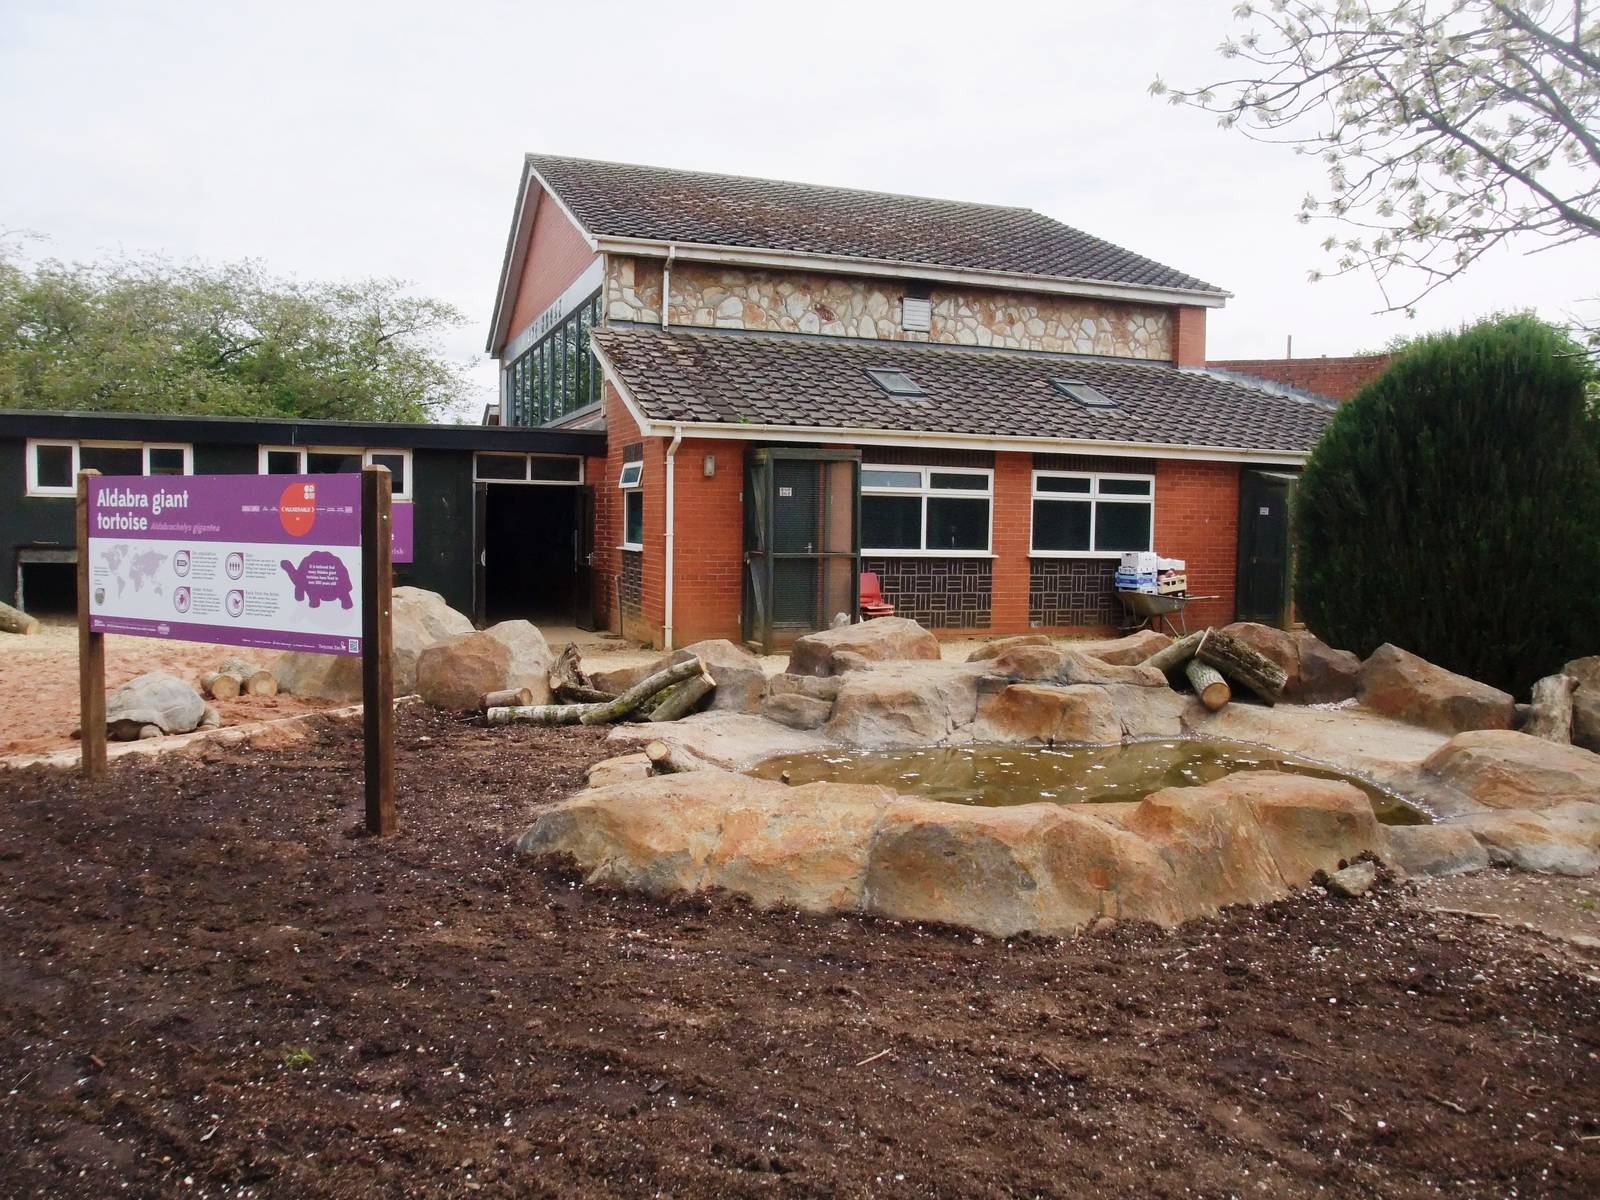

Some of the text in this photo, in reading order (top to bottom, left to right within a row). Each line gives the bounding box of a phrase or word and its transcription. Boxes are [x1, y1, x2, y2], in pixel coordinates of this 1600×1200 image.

[97, 488, 189, 515] Aldabra giant
[97, 512, 148, 530] tortoise
